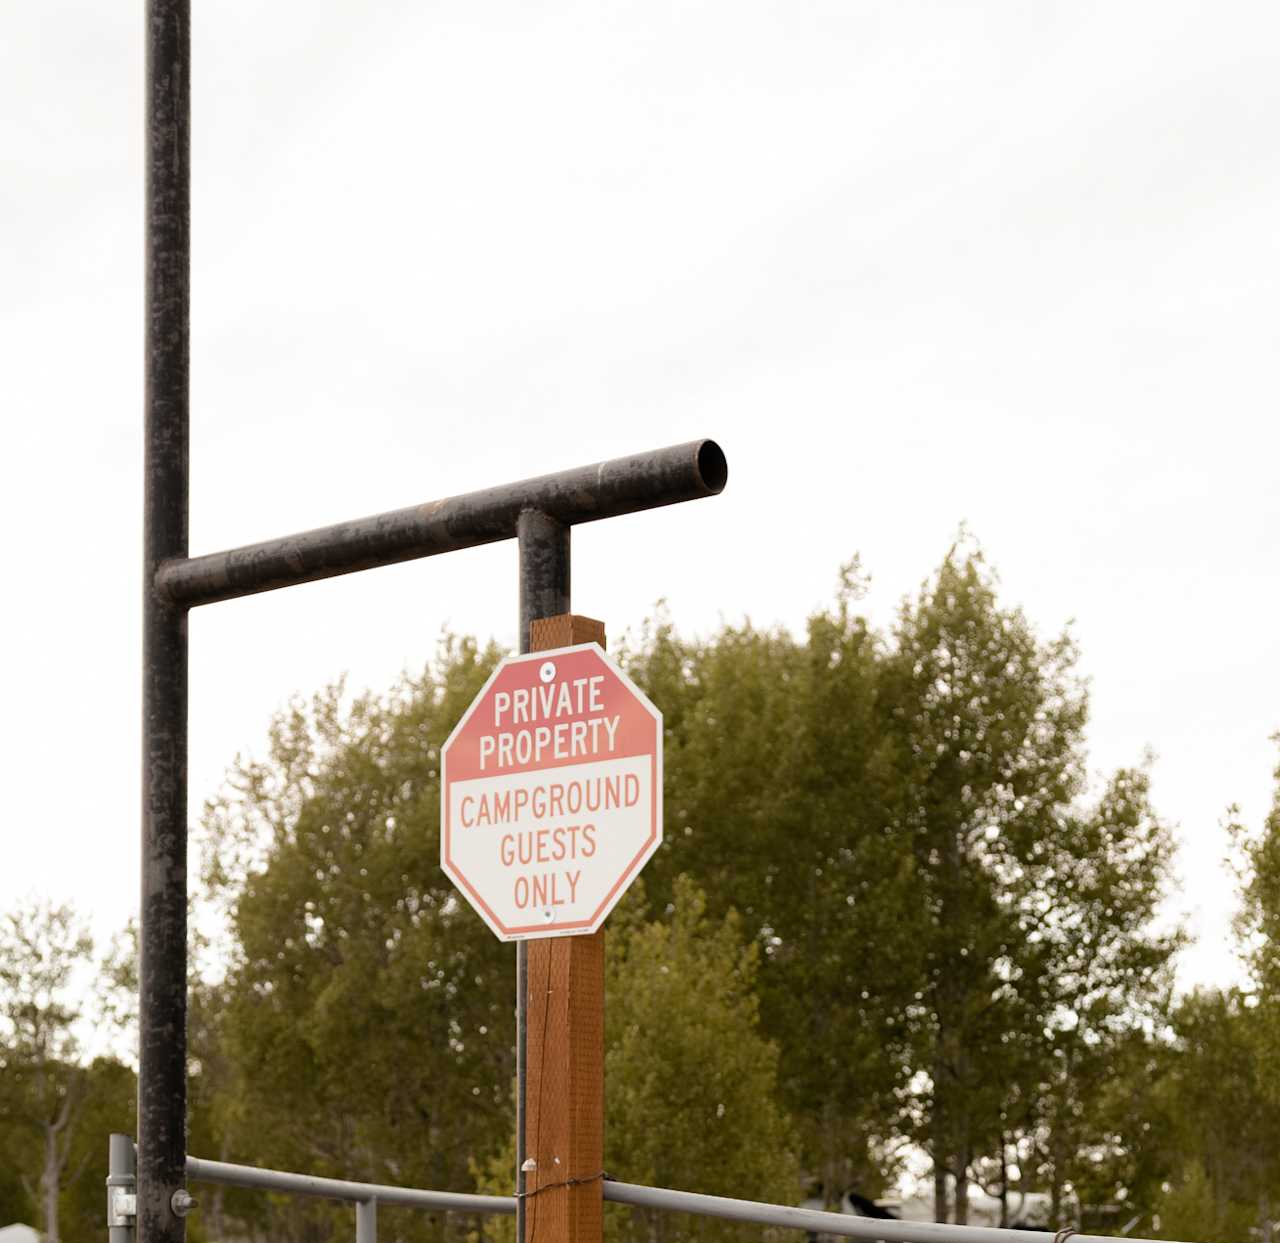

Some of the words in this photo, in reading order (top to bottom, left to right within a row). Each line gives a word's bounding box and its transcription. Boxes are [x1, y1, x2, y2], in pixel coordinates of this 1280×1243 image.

[494, 675, 605, 727] PRIVATE
[479, 715, 621, 770] PROPERTY
[460, 773, 640, 828] CAMPGROUND
[500, 824, 597, 866] GUESTS
[513, 870, 581, 909] ONLY
